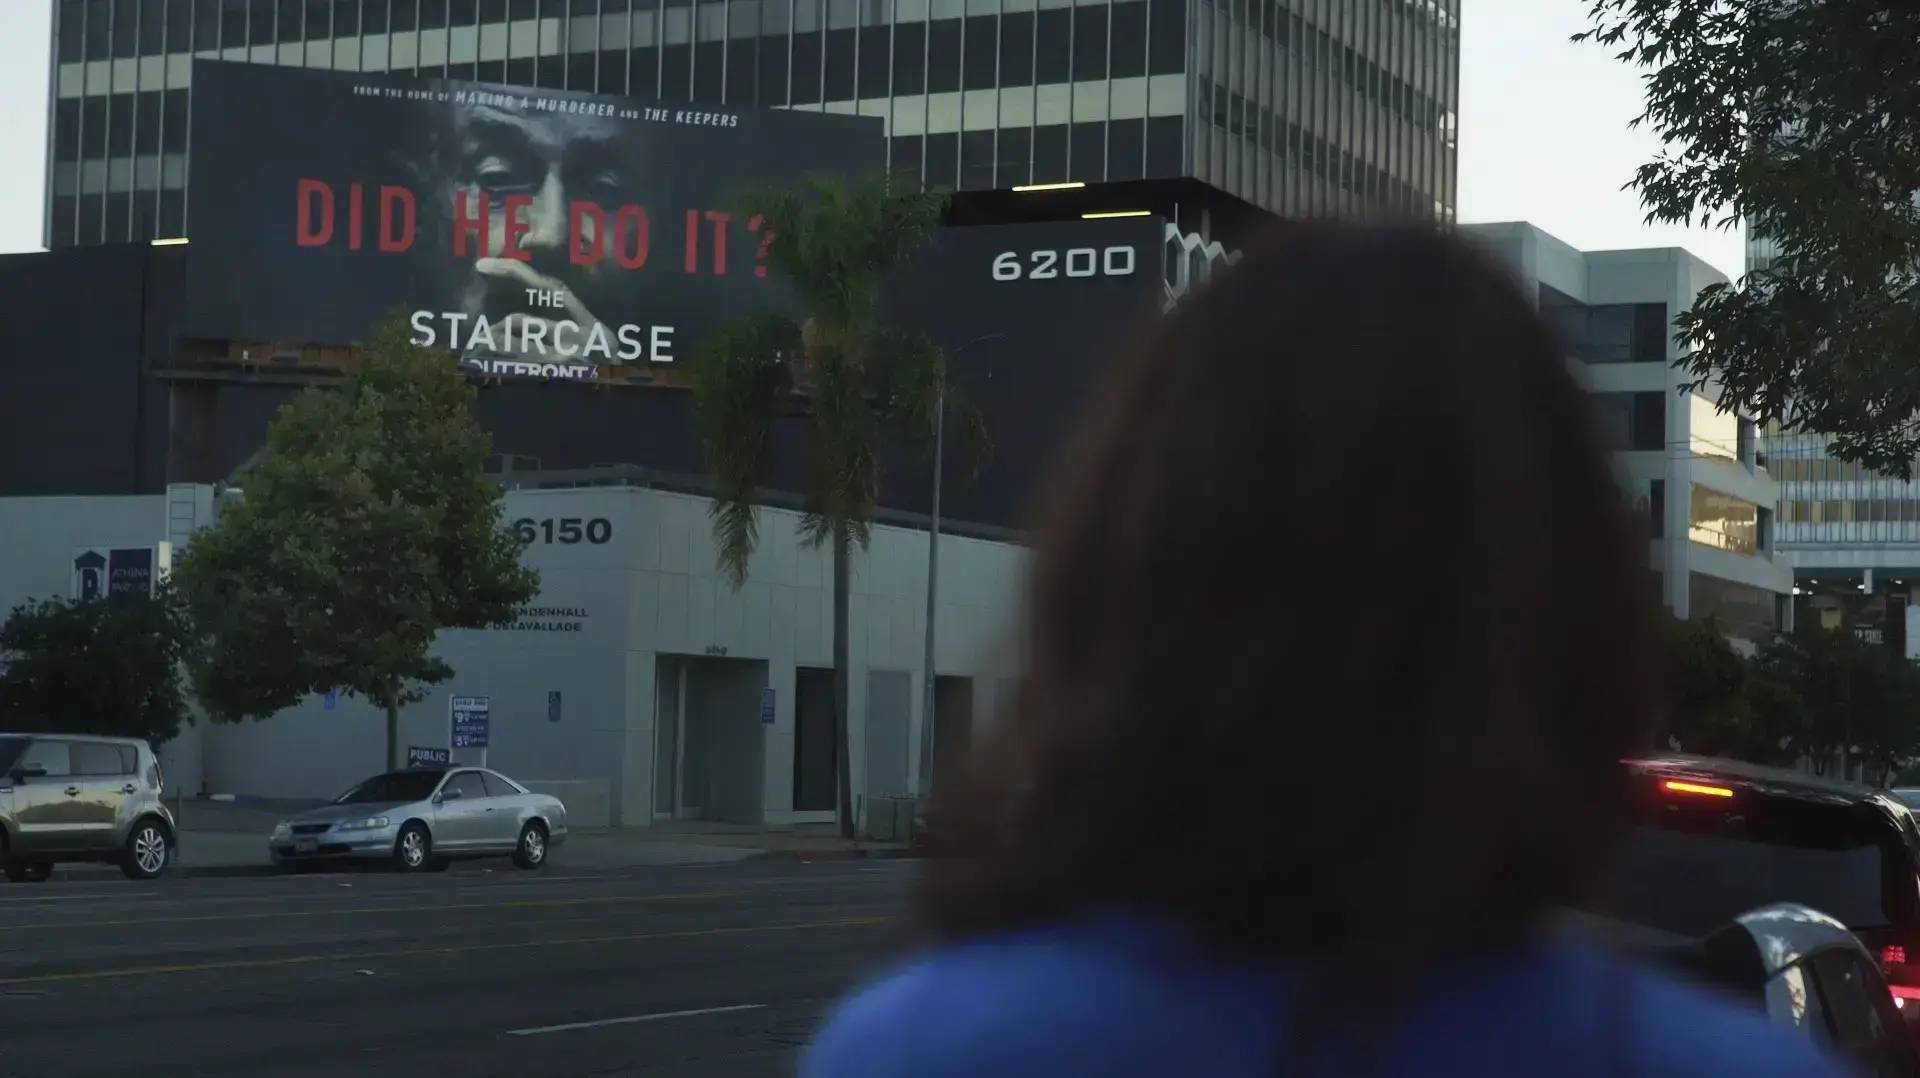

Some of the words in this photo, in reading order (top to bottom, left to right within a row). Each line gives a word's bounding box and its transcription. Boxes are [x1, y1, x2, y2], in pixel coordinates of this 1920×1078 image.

[353, 86, 380, 97] FROM
[385, 89, 403, 98] THE
[407, 91, 433, 101] HOME
[438, 94, 450, 102] OF
[455, 91, 514, 108] MAKING
[520, 97, 529, 109] A
[536, 99, 615, 117] MURDERER
[620, 110, 639, 119] AND
[645, 108, 669, 122] THE
[676, 110, 739, 127] KEEPERS
[297, 177, 416, 253] DID
[453, 186, 534, 261] HE
[569, 199, 651, 270] DO
[684, 209, 777, 278] IT?
[992, 245, 1137, 281] 6200
[525, 288, 565, 308] THE
[409, 309, 676, 363] STAIRCASE
[513, 518, 612, 544] 6150
[112, 567, 150, 580] ATHENA
[410, 749, 447, 762] PUBLIC
